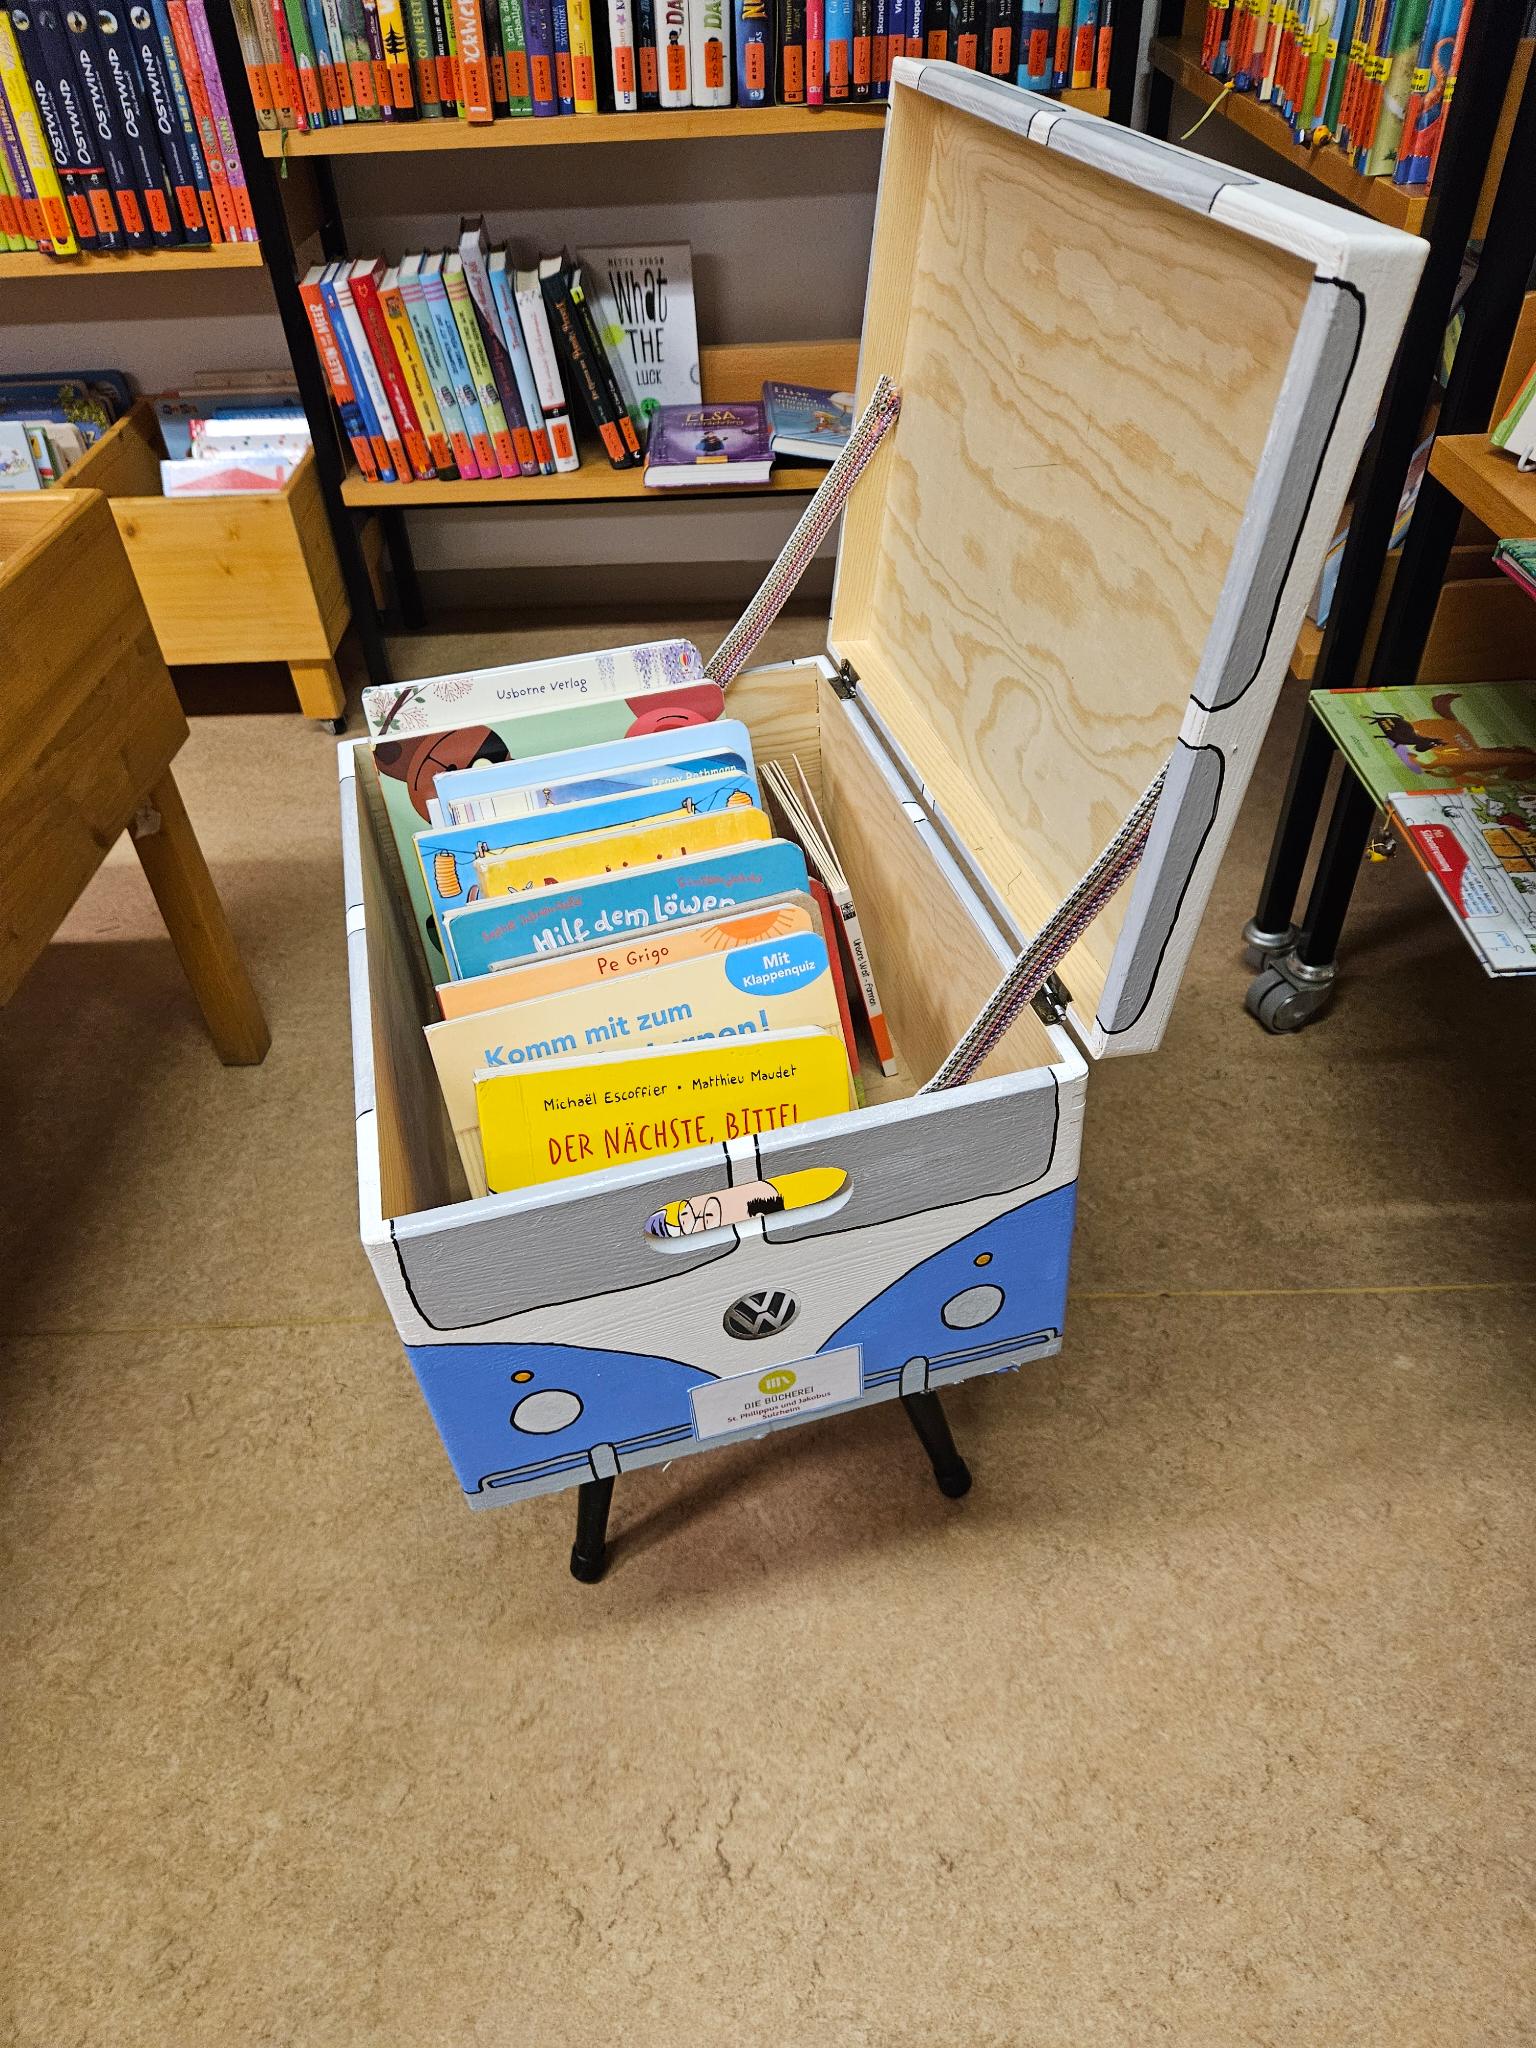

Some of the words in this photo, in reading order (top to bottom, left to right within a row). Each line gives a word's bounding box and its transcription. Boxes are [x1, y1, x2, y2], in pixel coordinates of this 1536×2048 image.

[80, 50, 112, 140] OSTWIND
[109, 48, 139, 138] OSTWIND
[142, 45, 171, 134] OSTWIND
[36, 79, 66, 165] OSTWIND
[60, 79, 90, 164] OSTWIND
[609, 267, 668, 325] What
[313, 303, 329, 336] MEER
[625, 328, 664, 364] THE
[636, 369, 662, 386] LUCK
[496, 684, 546, 700] Usborne
[550, 677, 587, 693] Verlag
[532, 918, 589, 952] Hilf
[594, 909, 650, 933] dem
[597, 955, 619, 975] Pe
[627, 945, 670, 968] Grigo
[742, 960, 816, 989] Klappenquiz
[763, 952, 791, 970] Mit
[484, 1029, 577, 1067] Komm
[585, 1014, 629, 1045] mit
[637, 1001, 693, 1032] zum
[544, 1094, 598, 1112] Michaël
[604, 1084, 668, 1105] Escoffier
[692, 1073, 745, 1092] Matthieu
[751, 1064, 798, 1083] Maudet
[549, 1134, 593, 1166] DER
[605, 1115, 714, 1159] NÄCHSTE,
[740, 1405, 779, 1419] Philippus
[781, 1400, 797, 1408] und
[798, 1392, 832, 1405] Jakobus
[744, 1401, 761, 1410] DIE
[765, 1386, 815, 1405] BÜCHEREI
